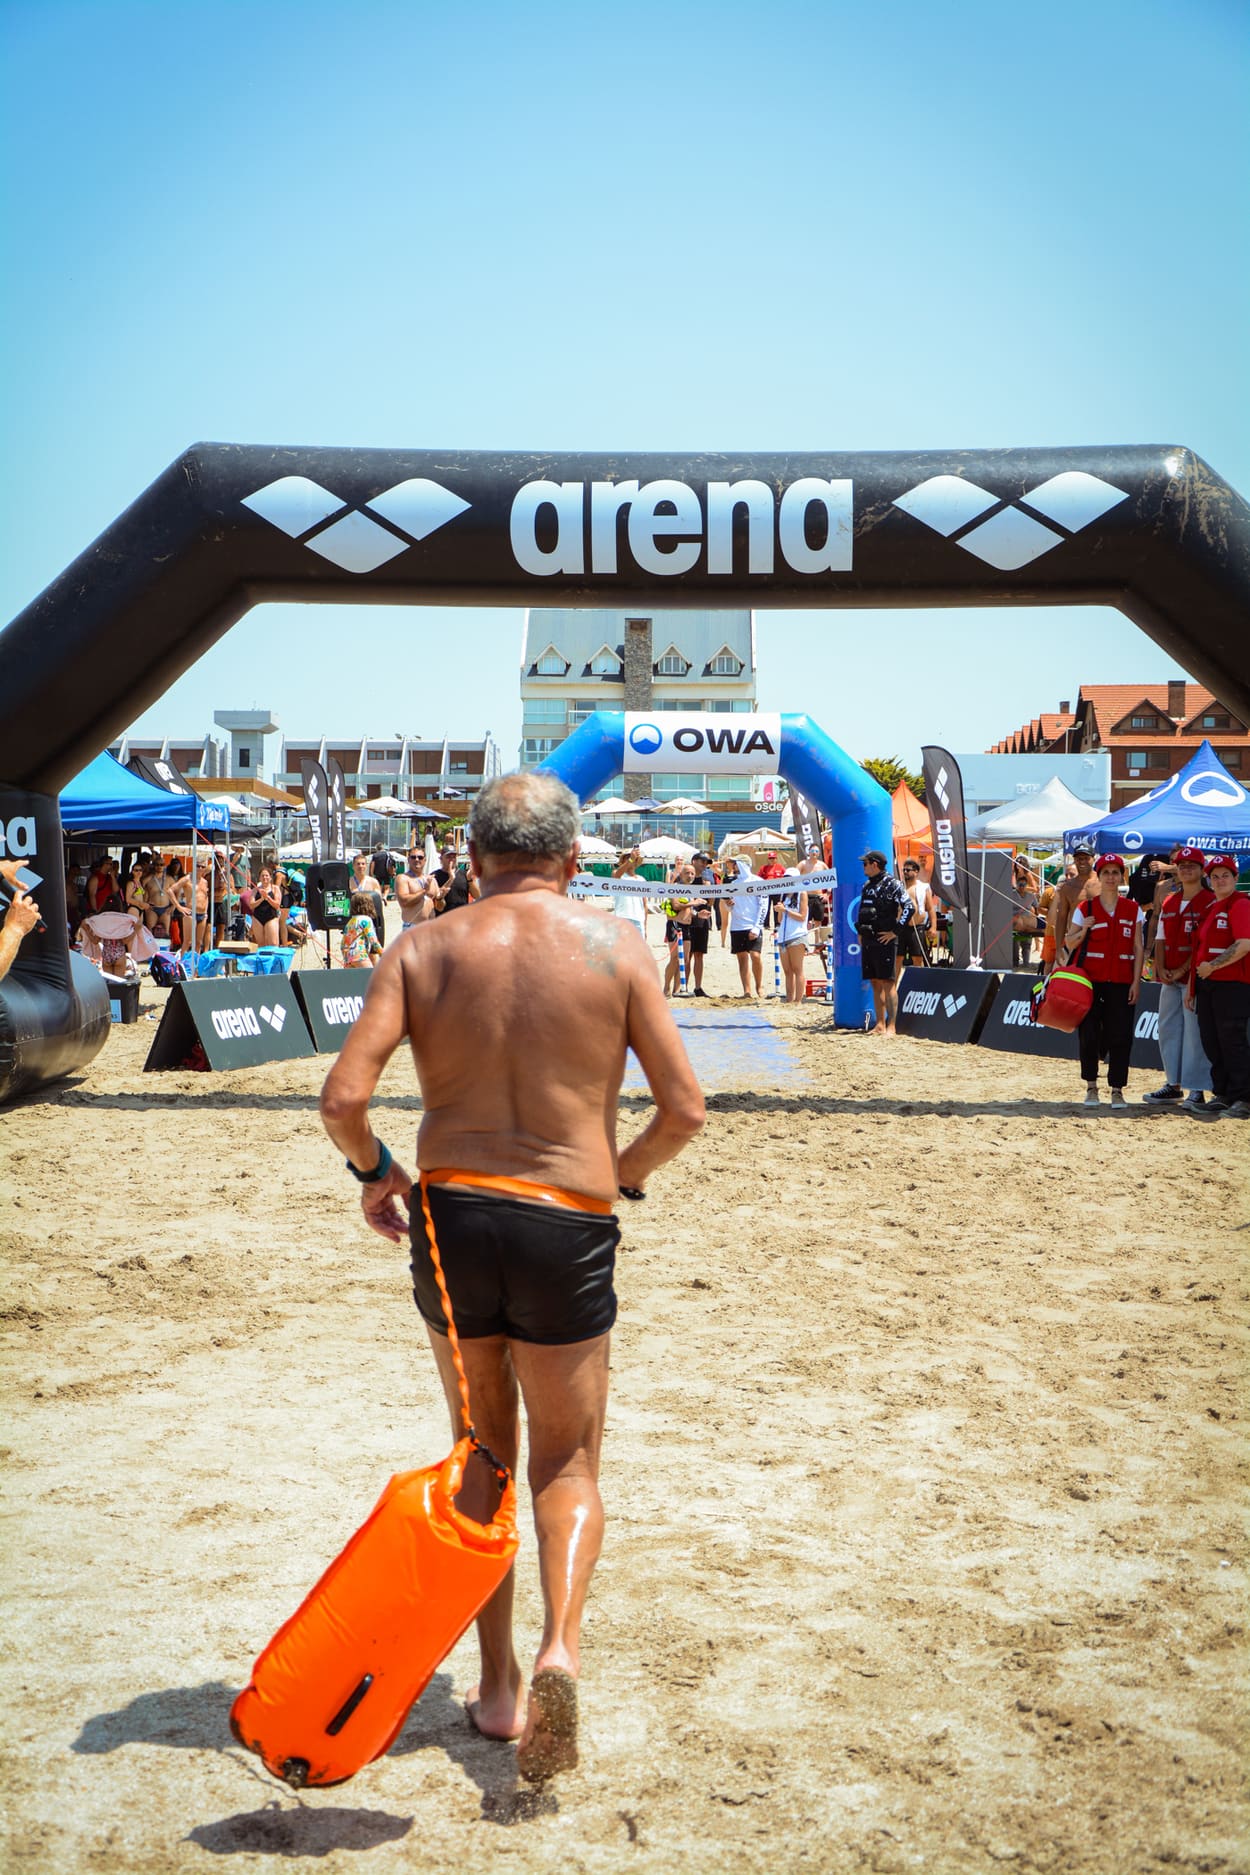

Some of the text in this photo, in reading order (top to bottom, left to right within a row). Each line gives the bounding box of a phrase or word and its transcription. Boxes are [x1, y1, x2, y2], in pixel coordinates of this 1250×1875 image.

[510, 478, 853, 576] arena
[673, 728, 775, 754] OWA
[755, 801, 783, 812] osde
[1187, 836, 1217, 848] OWA
[611, 884, 651, 893] GATORADE
[756, 881, 795, 892] GATORADE
[812, 875, 836, 884] OWA
[902, 990, 941, 1016] arena
[211, 1007, 262, 1040] arena
